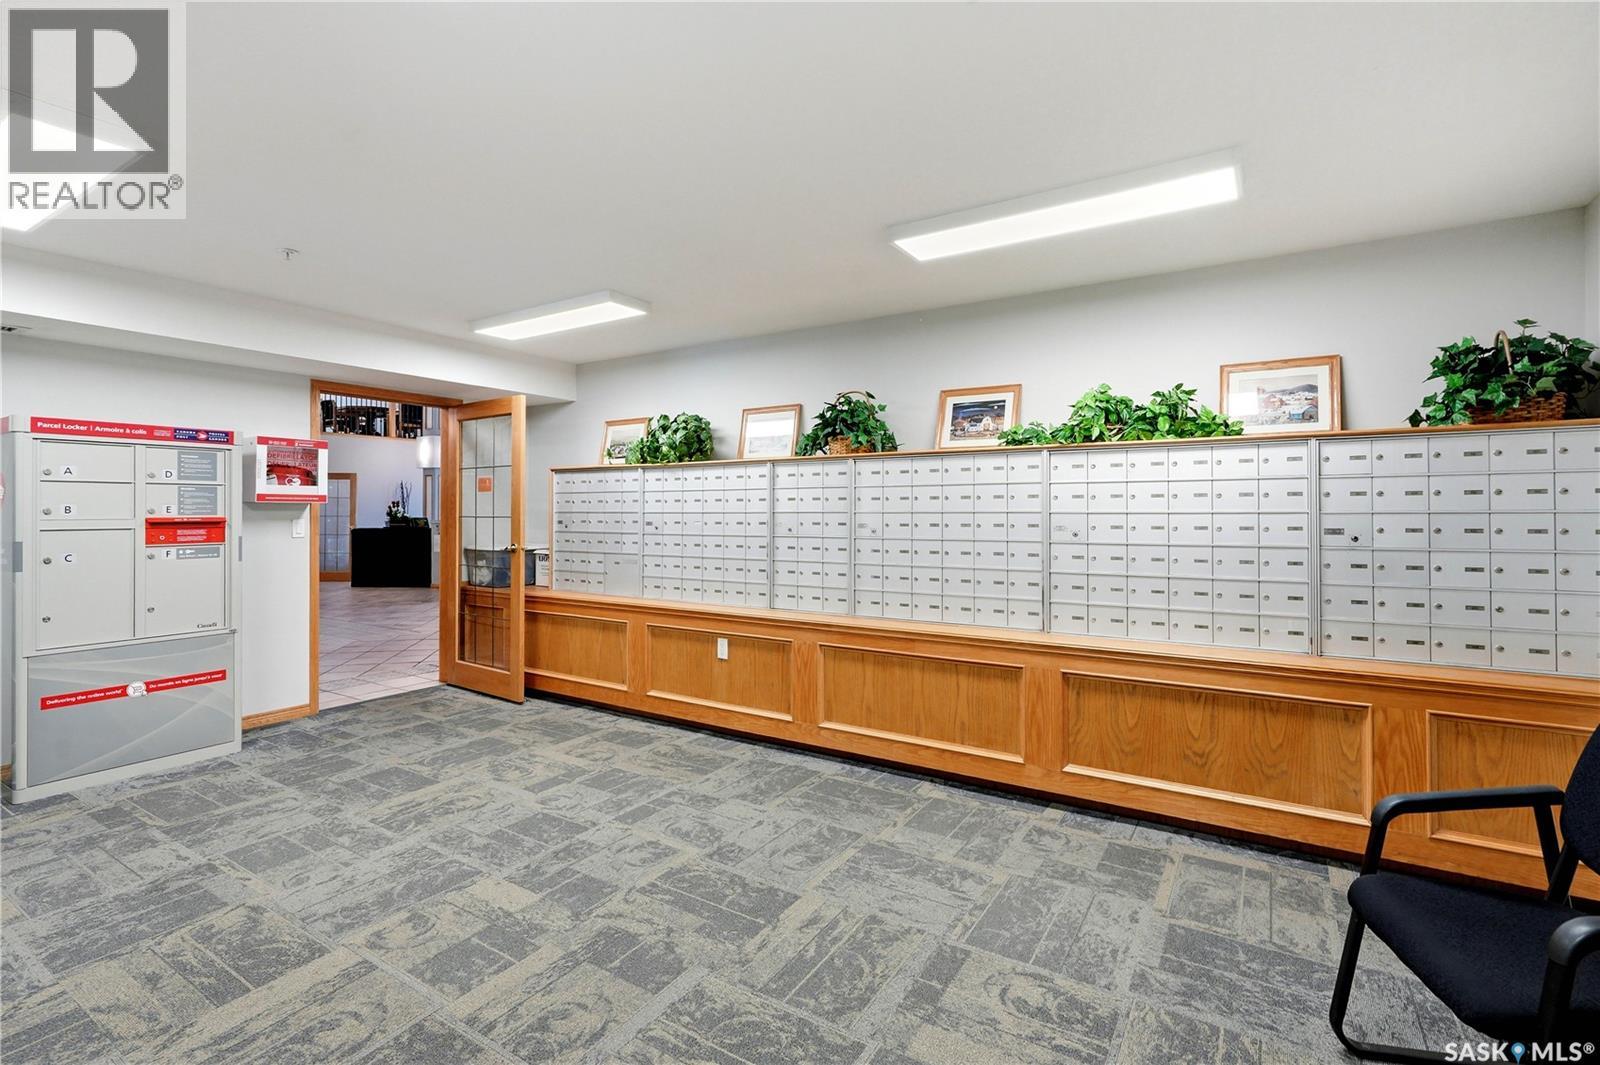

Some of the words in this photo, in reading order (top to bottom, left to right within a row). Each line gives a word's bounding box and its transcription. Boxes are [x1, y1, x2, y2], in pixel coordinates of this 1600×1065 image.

[37, 421, 61, 429] Parcel
[64, 467, 73, 475] A
[165, 471, 173, 479] D
[64, 505, 72, 514] B
[166, 505, 172, 514] E
[64, 554, 73, 562] C
[166, 550, 171, 558] F
[46, 696, 76, 705] Delivering
